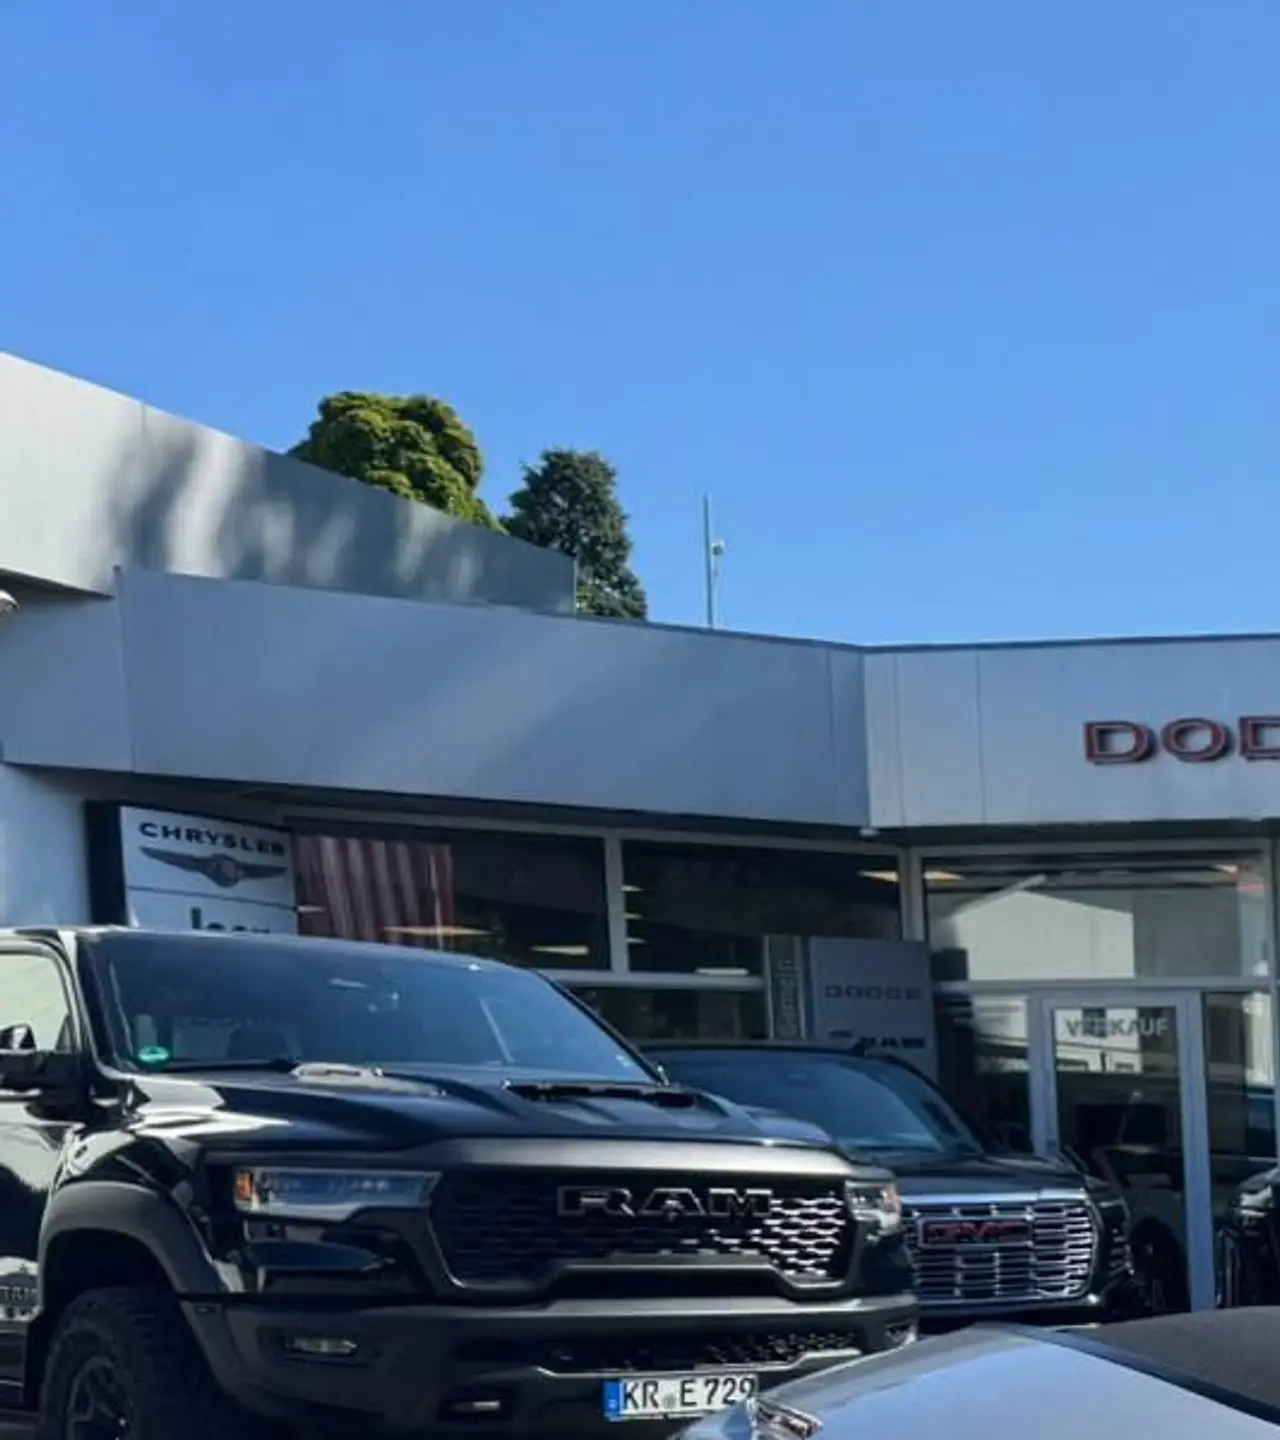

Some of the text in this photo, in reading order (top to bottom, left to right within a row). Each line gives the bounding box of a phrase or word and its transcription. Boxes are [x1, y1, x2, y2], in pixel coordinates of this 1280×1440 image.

[138, 822, 286, 857] CHRYSLER
[557, 1186, 773, 1217] RAM
[624, 1376, 757, 1411] KR E 729
